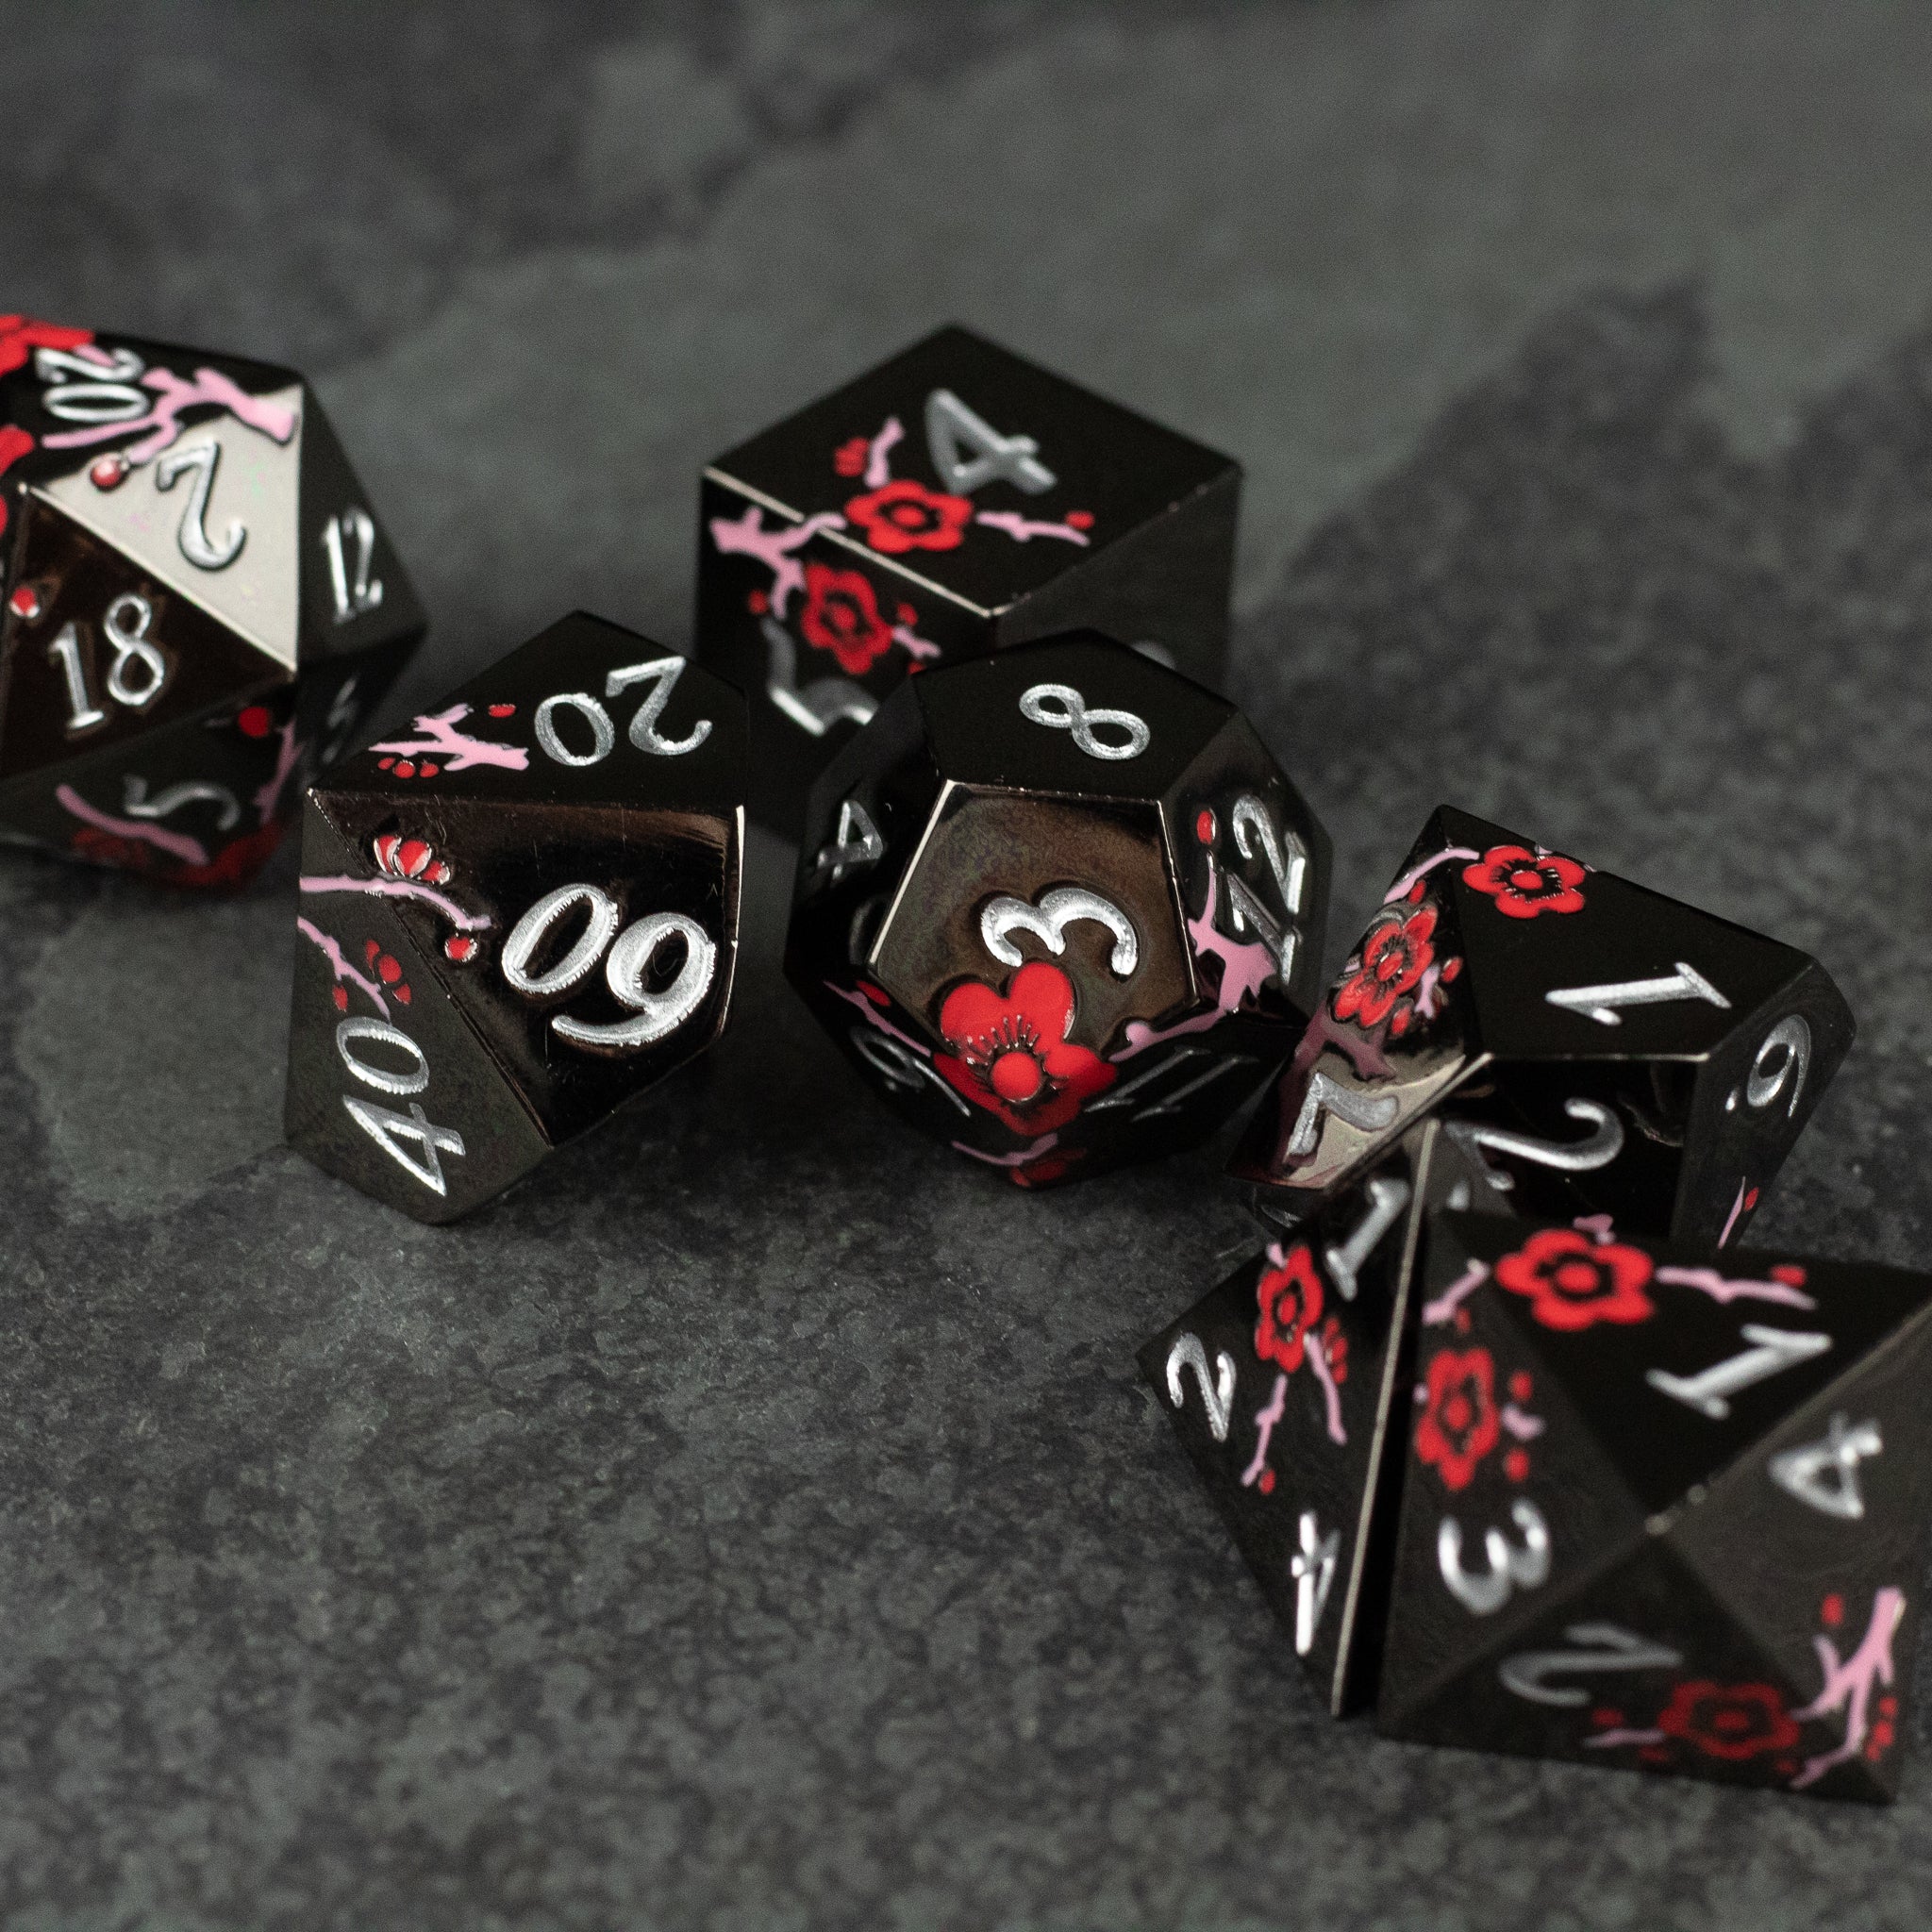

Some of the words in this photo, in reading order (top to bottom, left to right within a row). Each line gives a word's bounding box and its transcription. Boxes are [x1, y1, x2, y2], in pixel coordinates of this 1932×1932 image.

[34, 346, 149, 422] 20
[926, 389, 1057, 494] 4
[324, 509, 382, 623] 12
[48, 594, 166, 728] 18
[535, 657, 712, 766] 20
[1019, 683, 1151, 760] 8
[817, 800, 884, 880] 4
[1227, 793, 1307, 985] 12
[980, 888, 1138, 977] 3
[1545, 961, 1732, 1026] 1
[336, 1016, 466, 1197] 40
[1086, 1045, 1259, 1123] 11
[1287, 1072, 1398, 1158] 7
[1443, 1097, 1624, 1191] 2
[1328, 1179, 1410, 1300] 1
[1166, 1331, 1238, 1442] 2
[1647, 1324, 1832, 1419] 1
[1769, 1413, 1881, 1518] 4
[1291, 1511, 1341, 1657] 4
[1438, 1498, 1552, 1616] 3
[1500, 1622, 1684, 1707] 2
